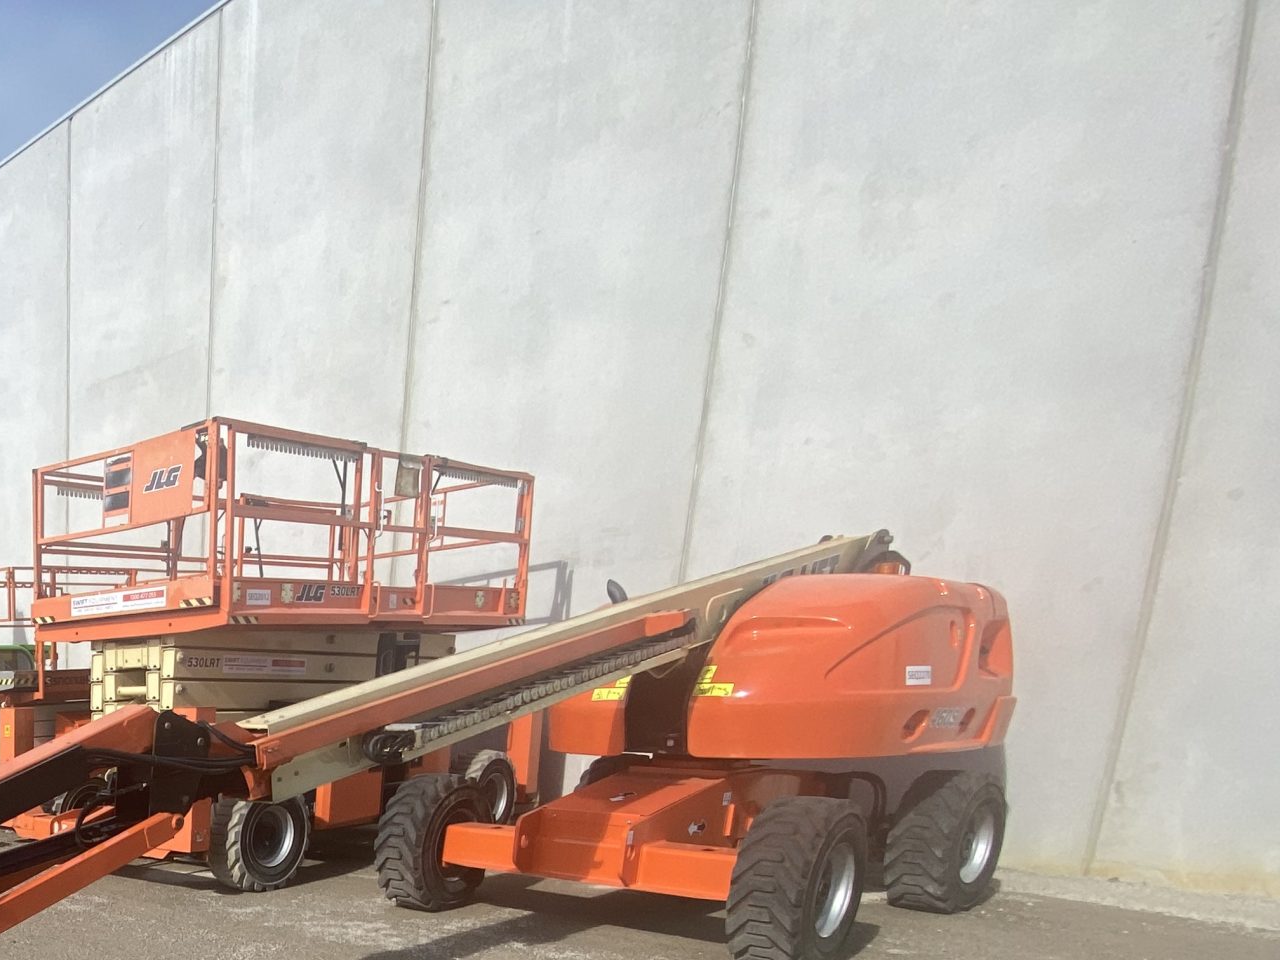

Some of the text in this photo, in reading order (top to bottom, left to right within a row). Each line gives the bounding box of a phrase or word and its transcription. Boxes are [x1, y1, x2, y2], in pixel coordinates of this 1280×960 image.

[143, 464, 182, 493] JLG
[295, 583, 360, 603] JLG 530LRT
[187, 657, 220, 668] 530LRT
